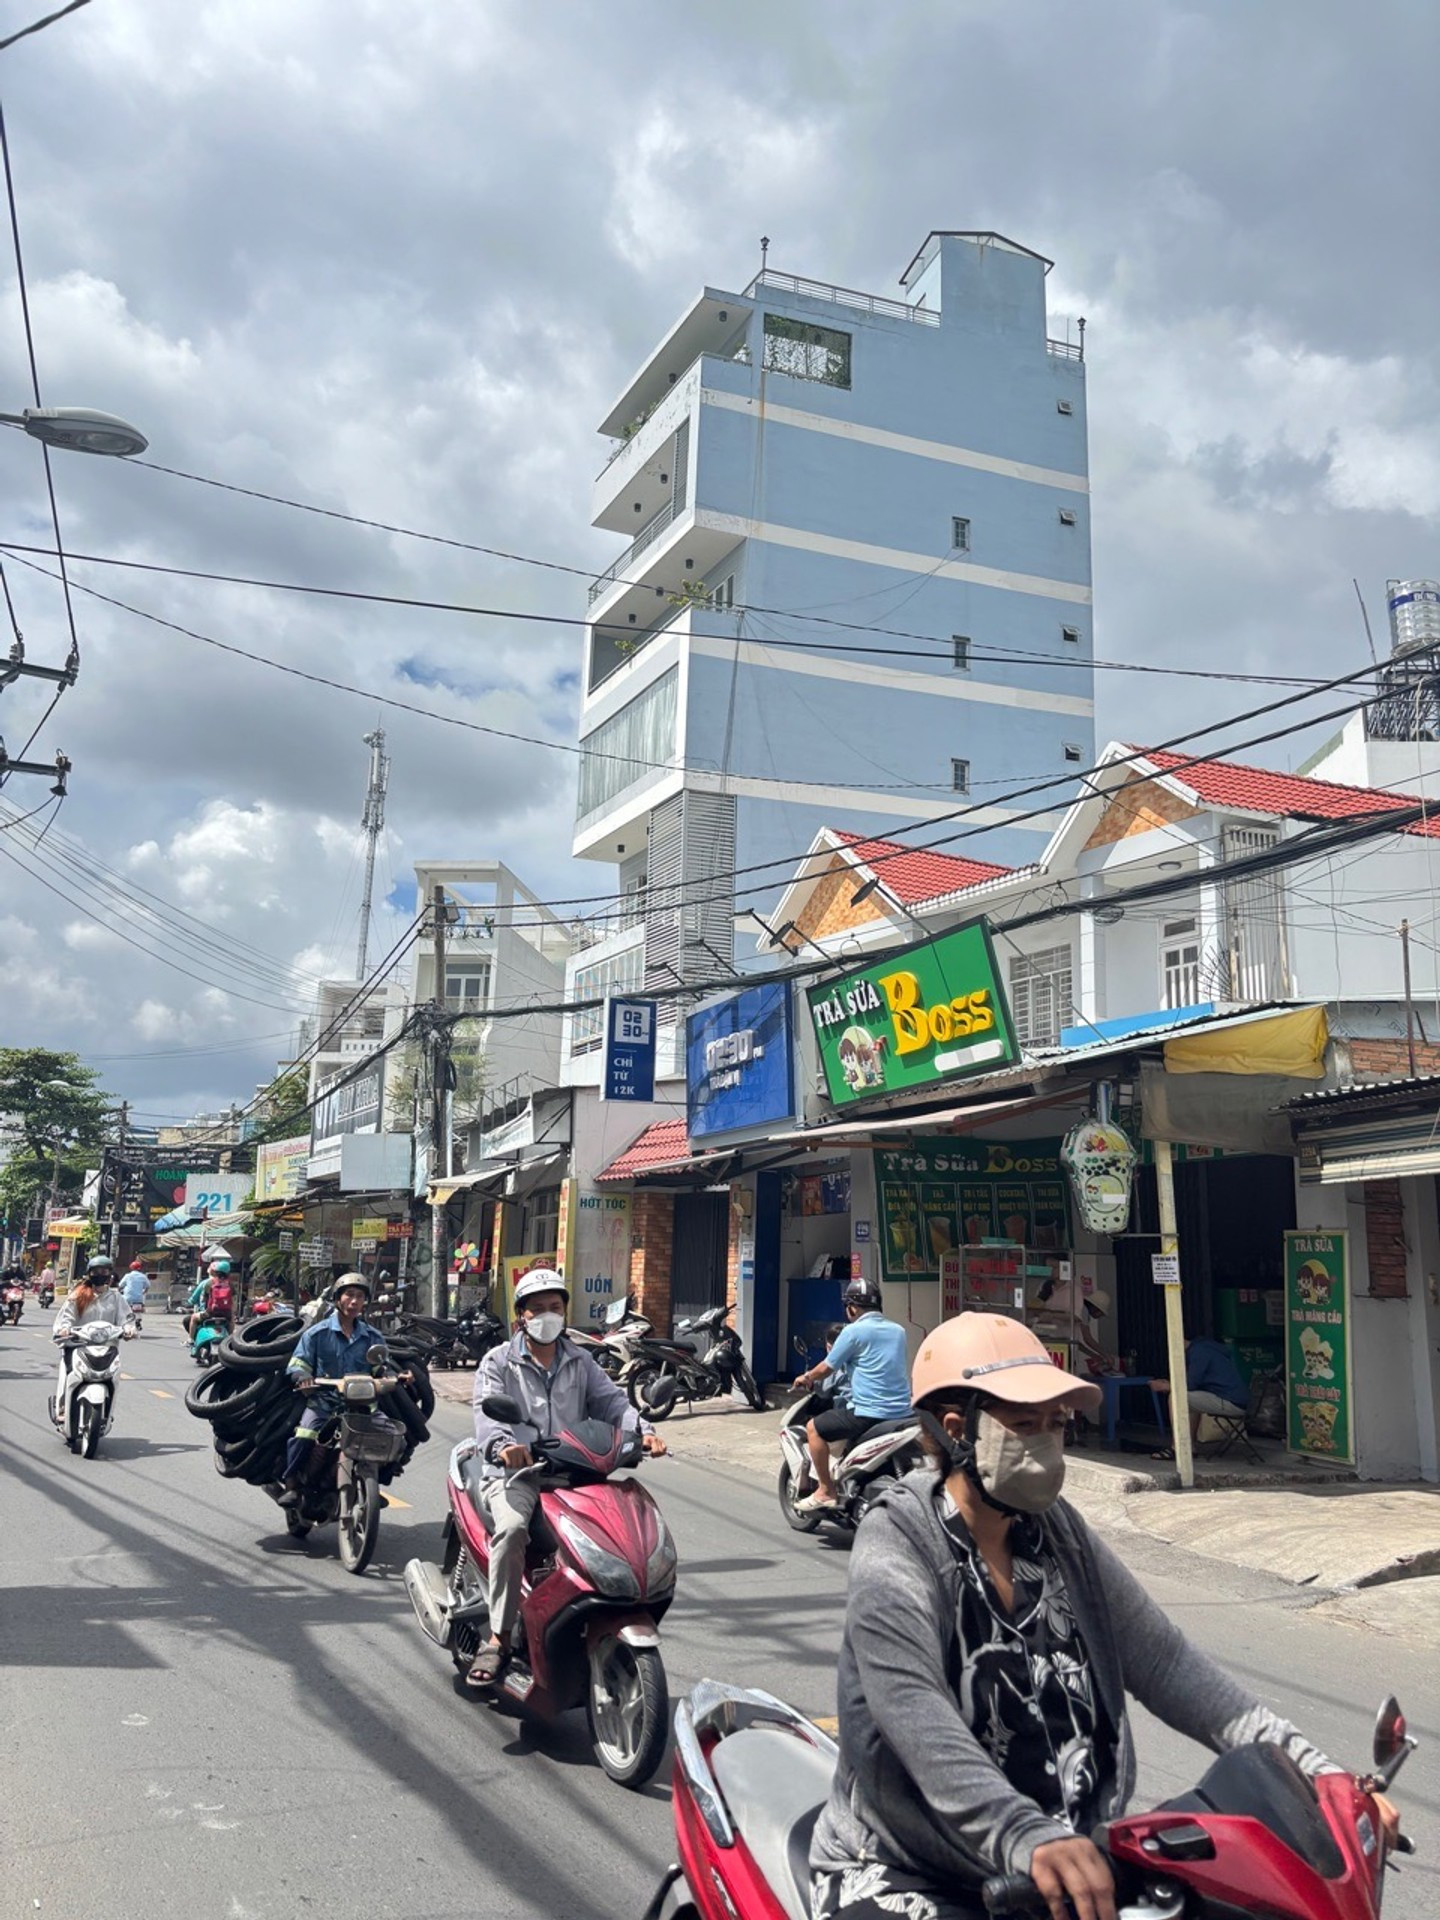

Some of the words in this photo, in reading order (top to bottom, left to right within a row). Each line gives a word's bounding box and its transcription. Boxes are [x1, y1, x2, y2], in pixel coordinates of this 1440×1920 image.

[623, 1010, 642, 1024] 02
[813, 988, 845, 1027] TRÀ
[847, 979, 880, 1016] SỮA
[879, 971, 993, 1055] Boss
[622, 1025, 642, 1037] 30
[883, 1152, 928, 1172] Trà
[934, 1153, 979, 1172] Sữa
[196, 1193, 232, 1212] 221
[580, 1196, 601, 1209] HỚT
[605, 1197, 626, 1210] TÓC
[1295, 1236, 1313, 1252] TRÀ
[1314, 1236, 1334, 1252] SỮA
[585, 1272, 612, 1293] UỐN
